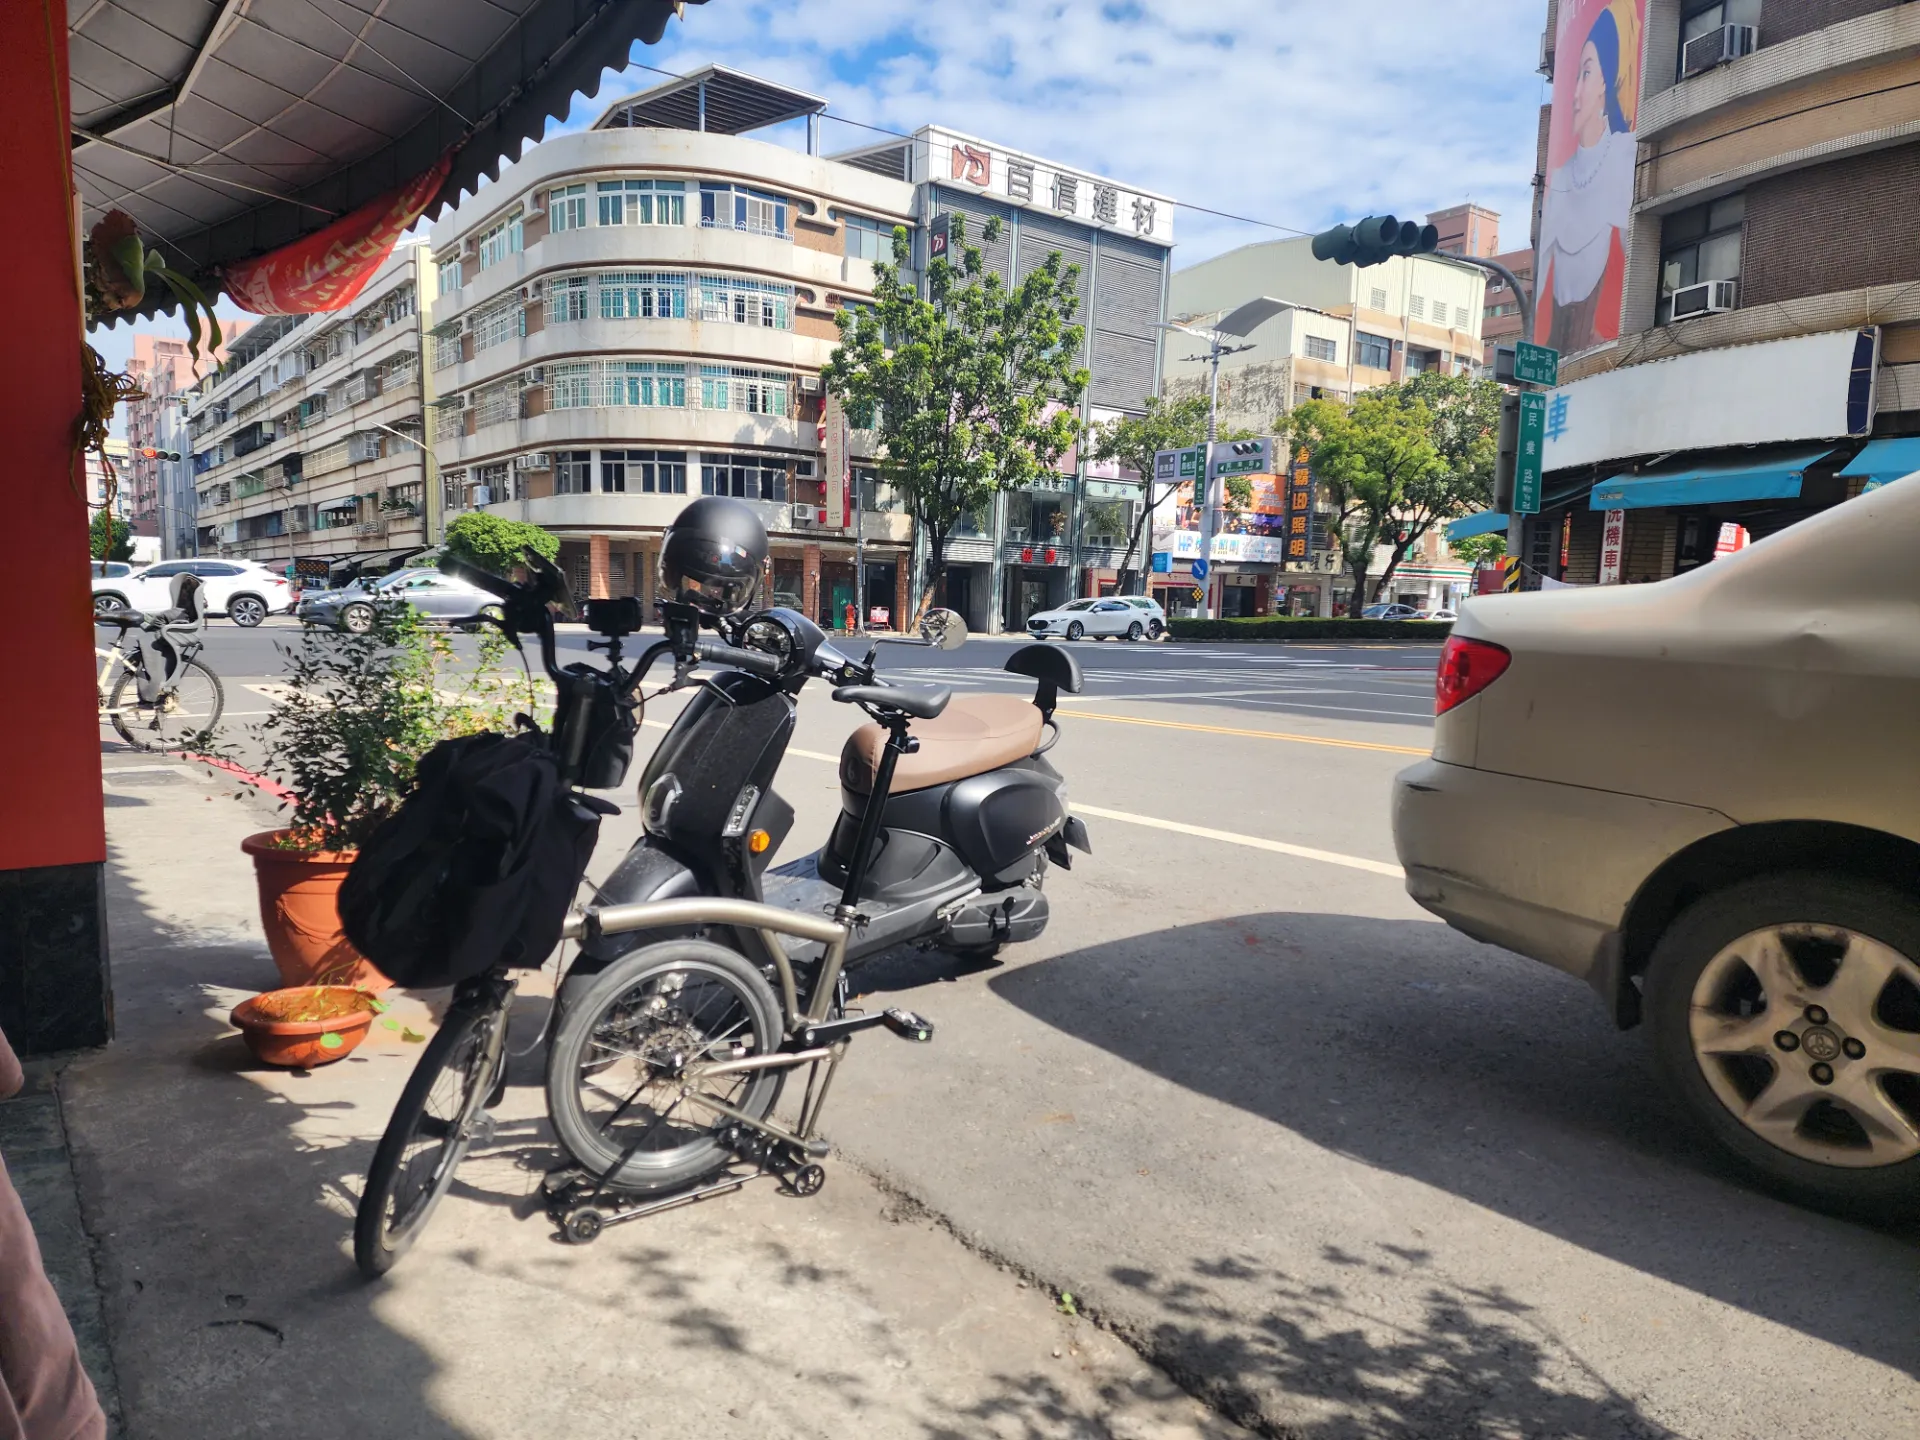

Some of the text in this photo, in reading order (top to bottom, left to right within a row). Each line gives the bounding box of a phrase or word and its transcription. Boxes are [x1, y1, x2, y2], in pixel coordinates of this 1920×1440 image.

[1007, 157, 1157, 235] 百信建材
[1521, 345, 1552, 366] 九如一路
